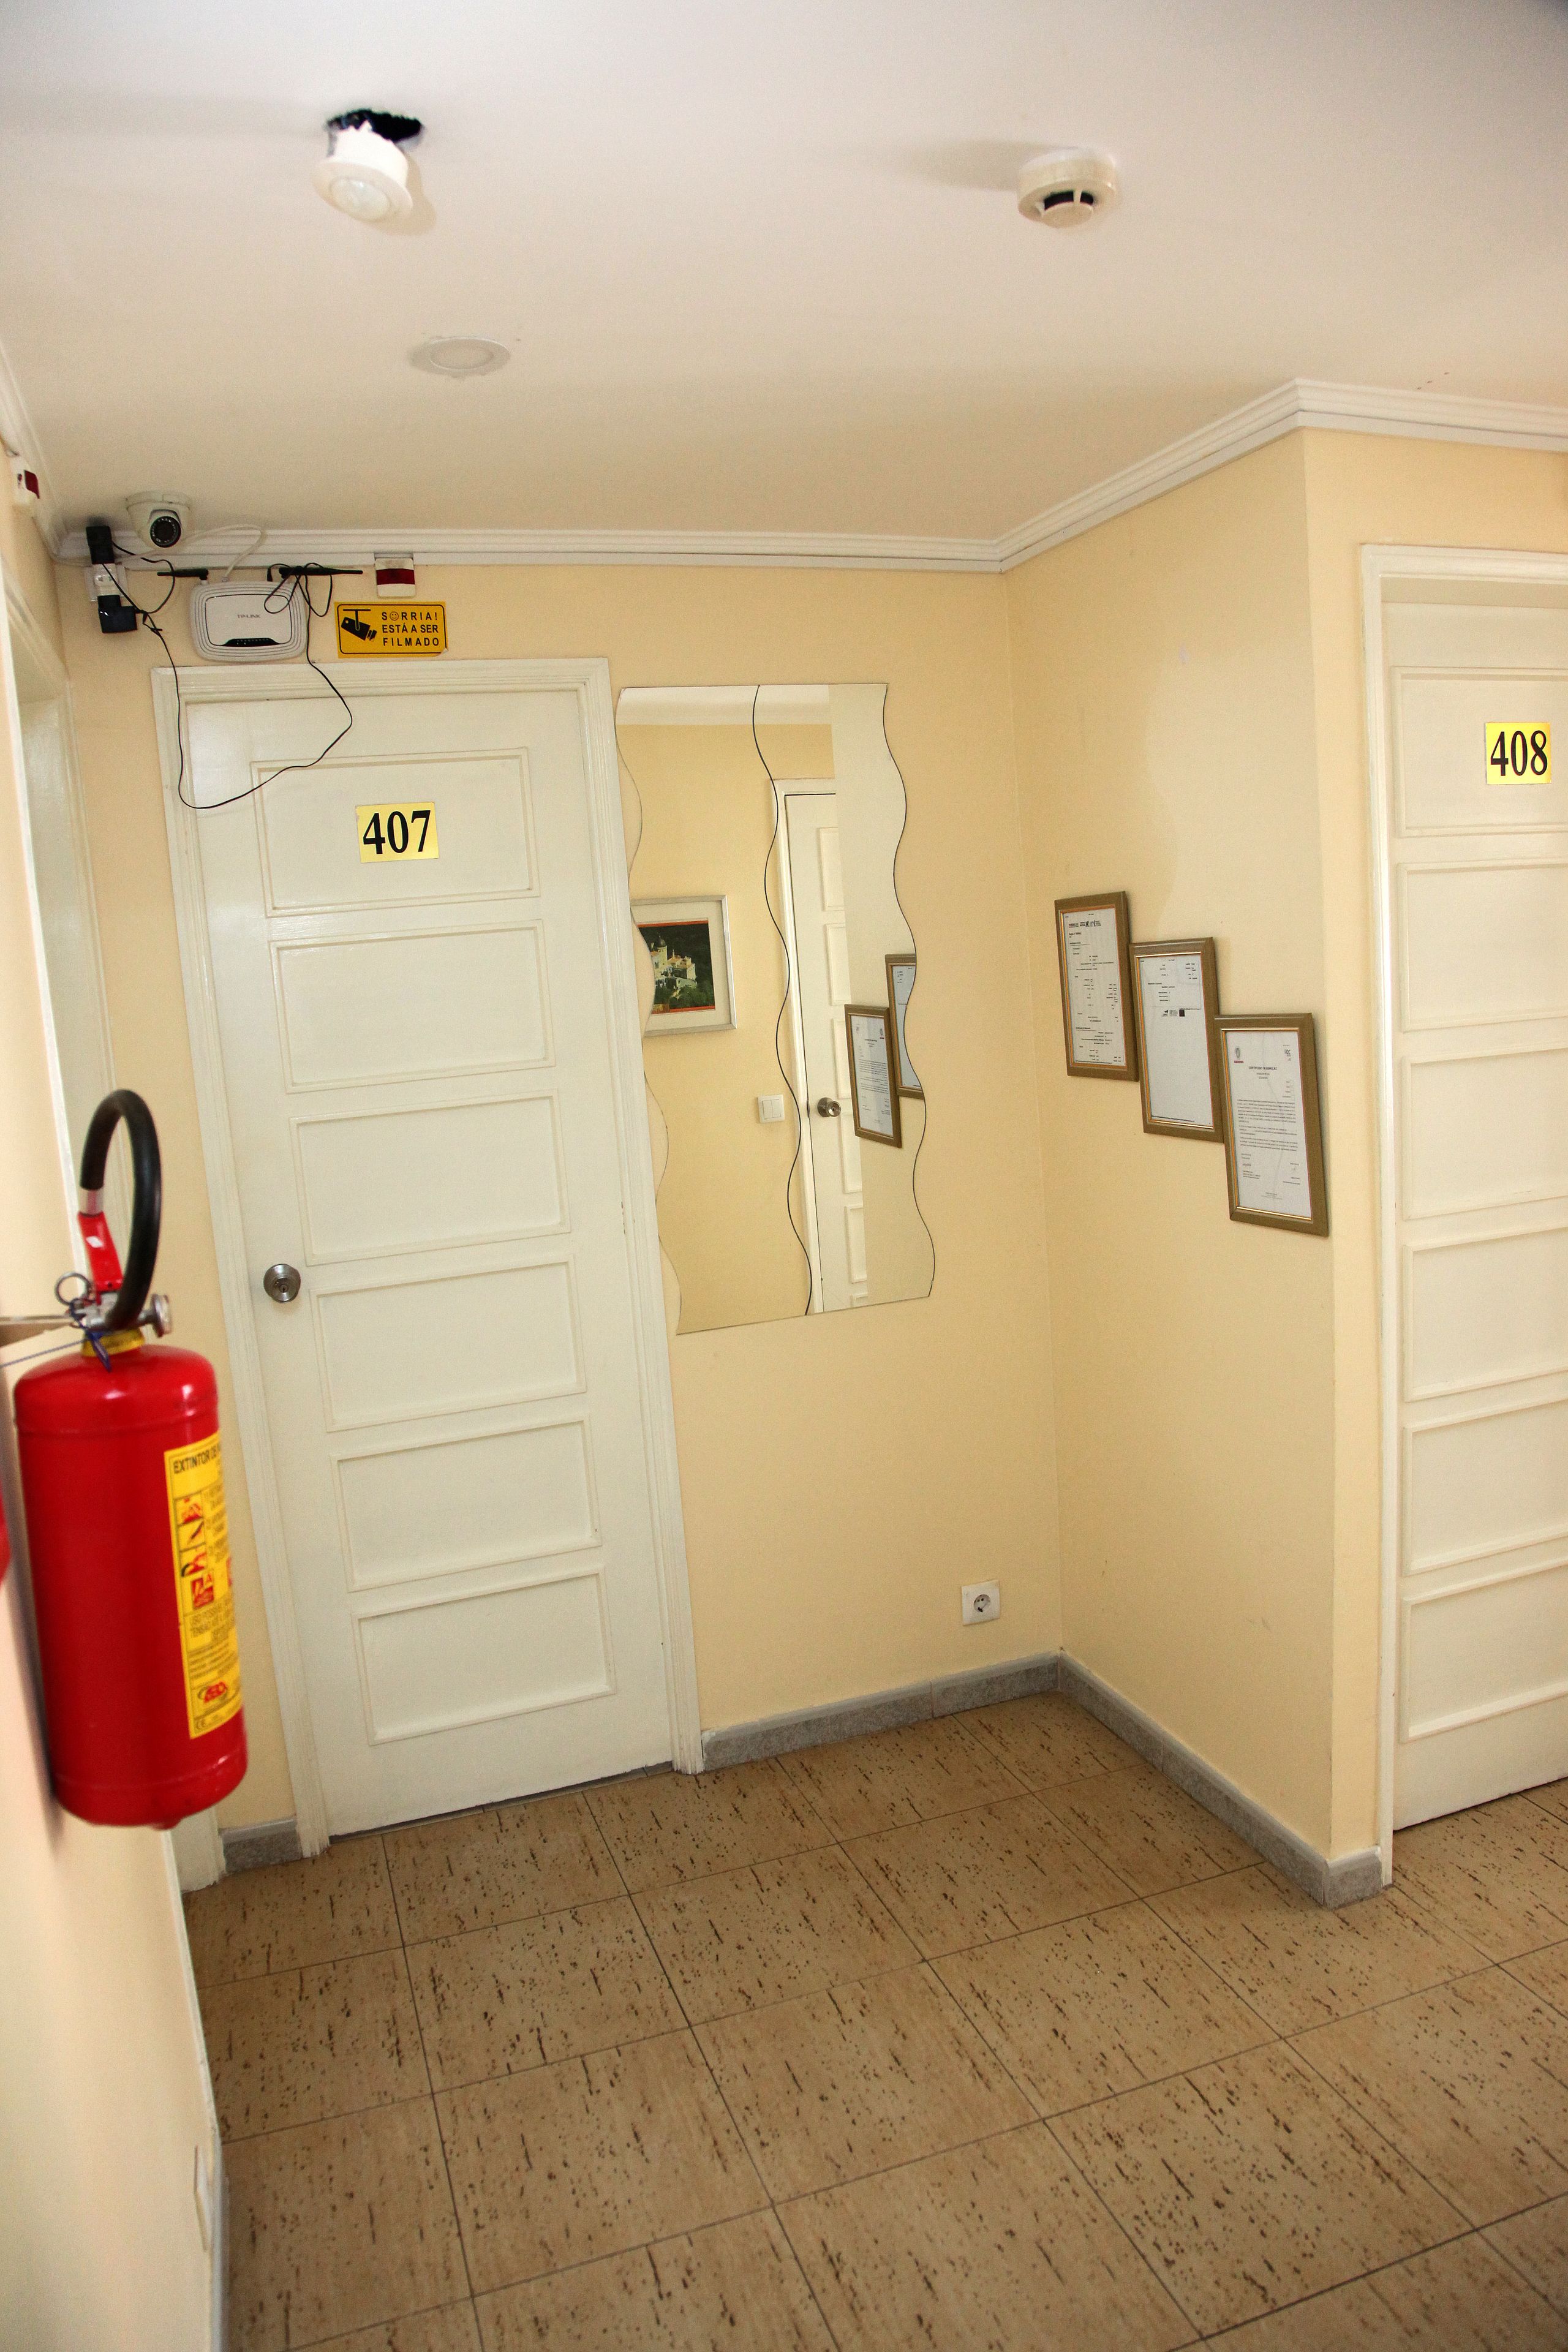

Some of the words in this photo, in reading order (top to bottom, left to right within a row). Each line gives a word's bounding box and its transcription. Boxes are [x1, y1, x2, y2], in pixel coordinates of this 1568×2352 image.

[382, 623, 408, 633] ESTÁ
[411, 624, 417, 633] A
[420, 624, 439, 633] SER
[383, 638, 439, 646] FILMADO
[1490, 730, 1548, 776] 408
[363, 810, 431, 854] 407
[173, 1450, 209, 1474] EXTINTOR
